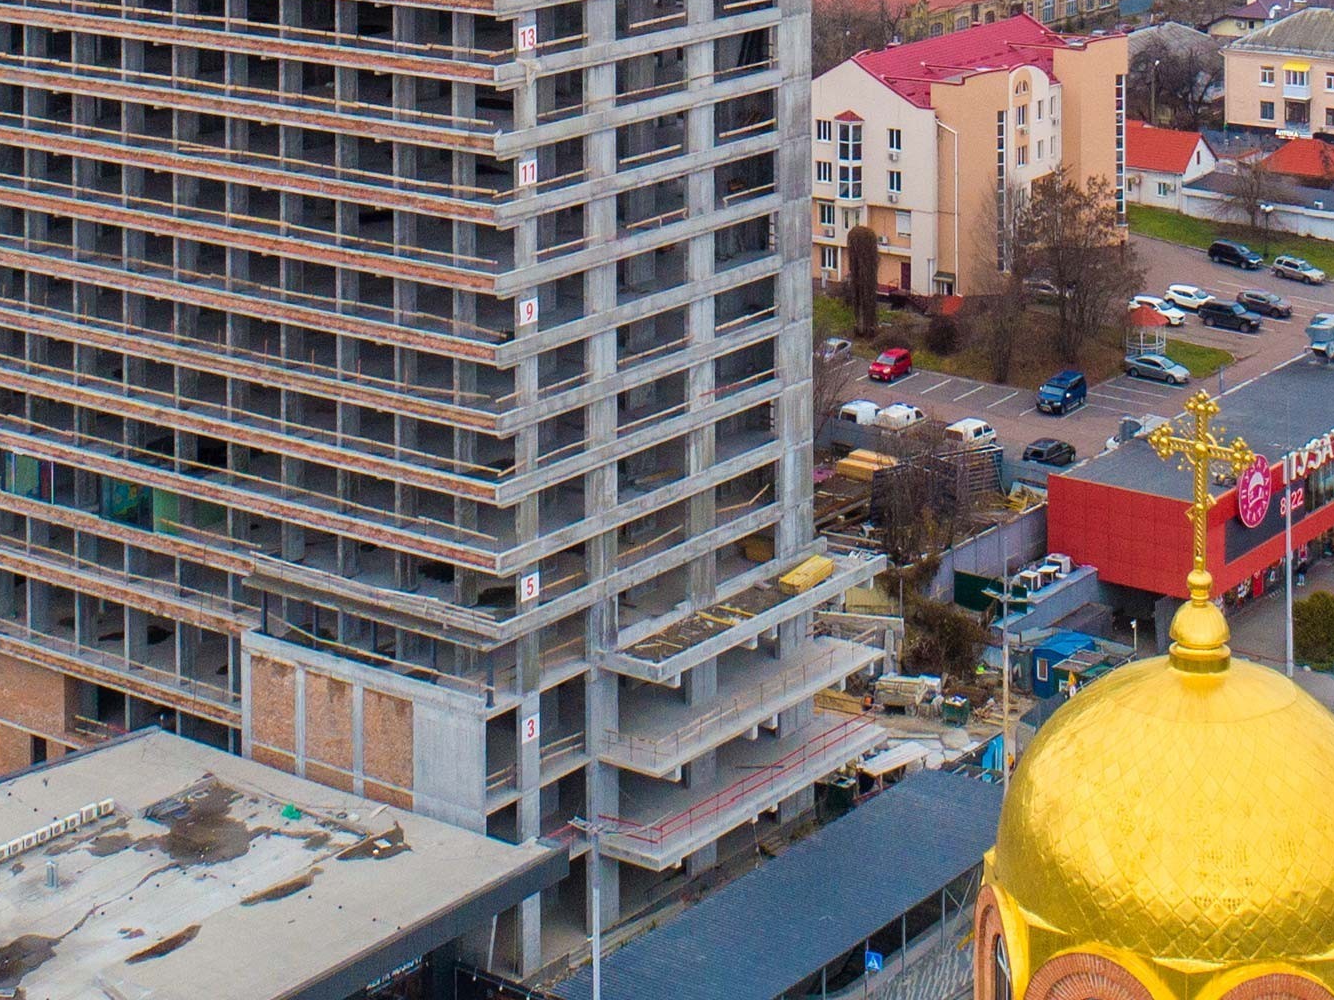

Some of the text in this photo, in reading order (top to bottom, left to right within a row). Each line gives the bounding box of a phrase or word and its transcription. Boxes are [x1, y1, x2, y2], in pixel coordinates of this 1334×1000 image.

[520, 28, 535, 48] 13
[522, 162, 535, 183] 11
[526, 302, 534, 321] 9
[526, 577, 534, 597] 5
[526, 719, 535, 738] 3
